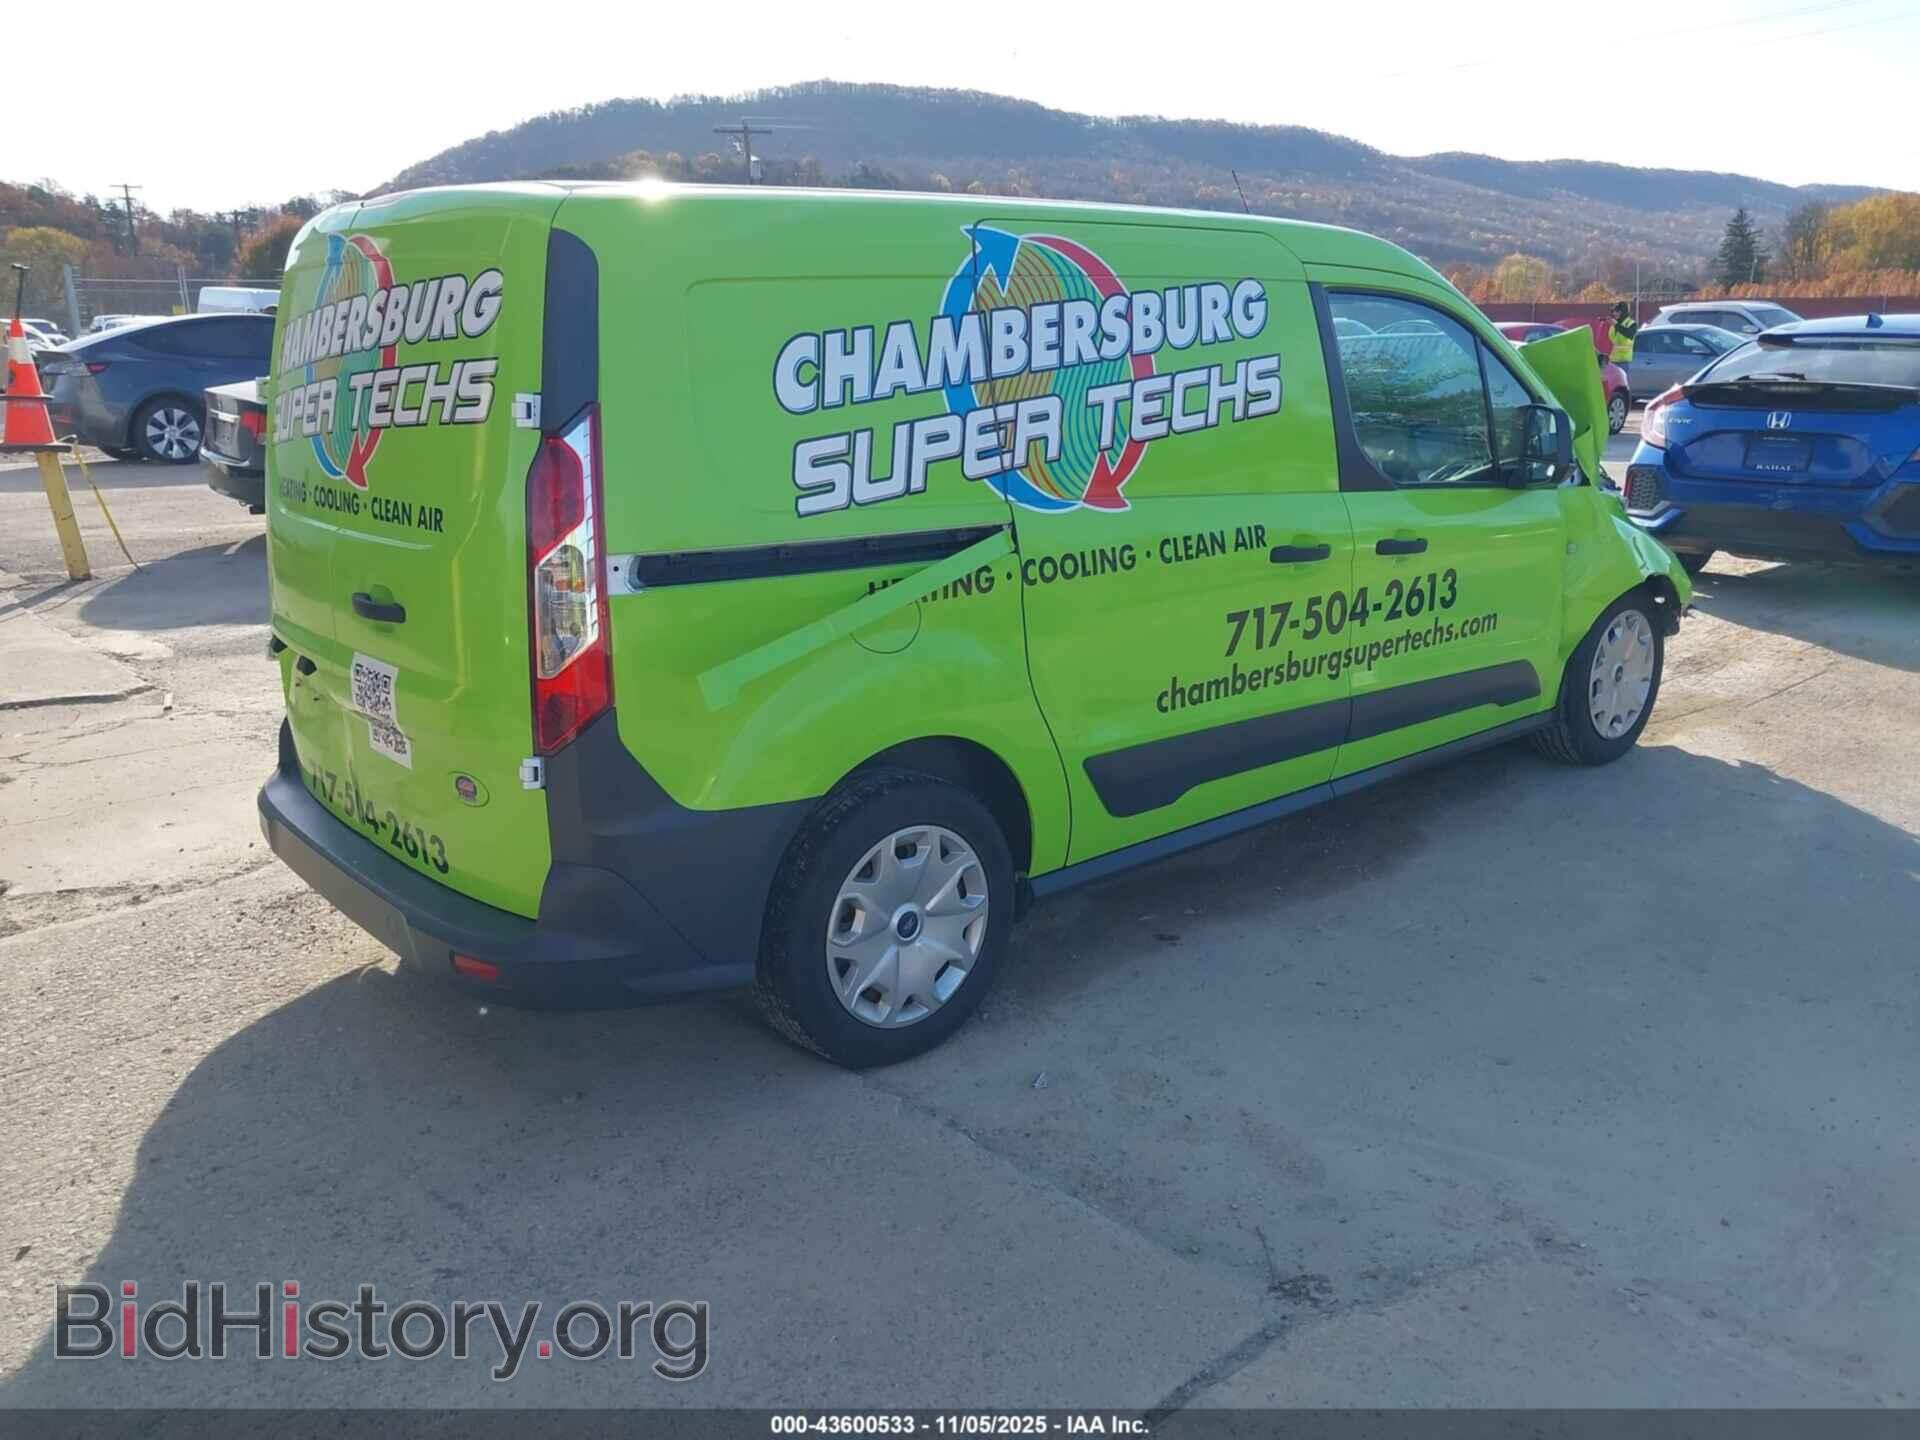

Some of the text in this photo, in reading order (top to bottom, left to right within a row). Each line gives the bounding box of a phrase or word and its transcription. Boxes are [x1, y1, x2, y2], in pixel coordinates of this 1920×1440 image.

[279, 267, 504, 372] HAMBERSBURG
[772, 278, 1270, 414] CHAMBERSBURG
[347, 357, 499, 431] TECHS
[791, 353, 1283, 518] SUPER TECHS
[313, 485, 361, 516] COOLING
[370, 497, 412, 527] CLEAN
[417, 505, 445, 533] AIR
[1022, 543, 1138, 588] COOLING
[1158, 530, 1226, 565] CLEAN
[1233, 523, 1268, 553] AIR
[1223, 567, 1458, 658] 717-504-2613
[1156, 611, 1499, 714] chambersburgsupertechs.com
